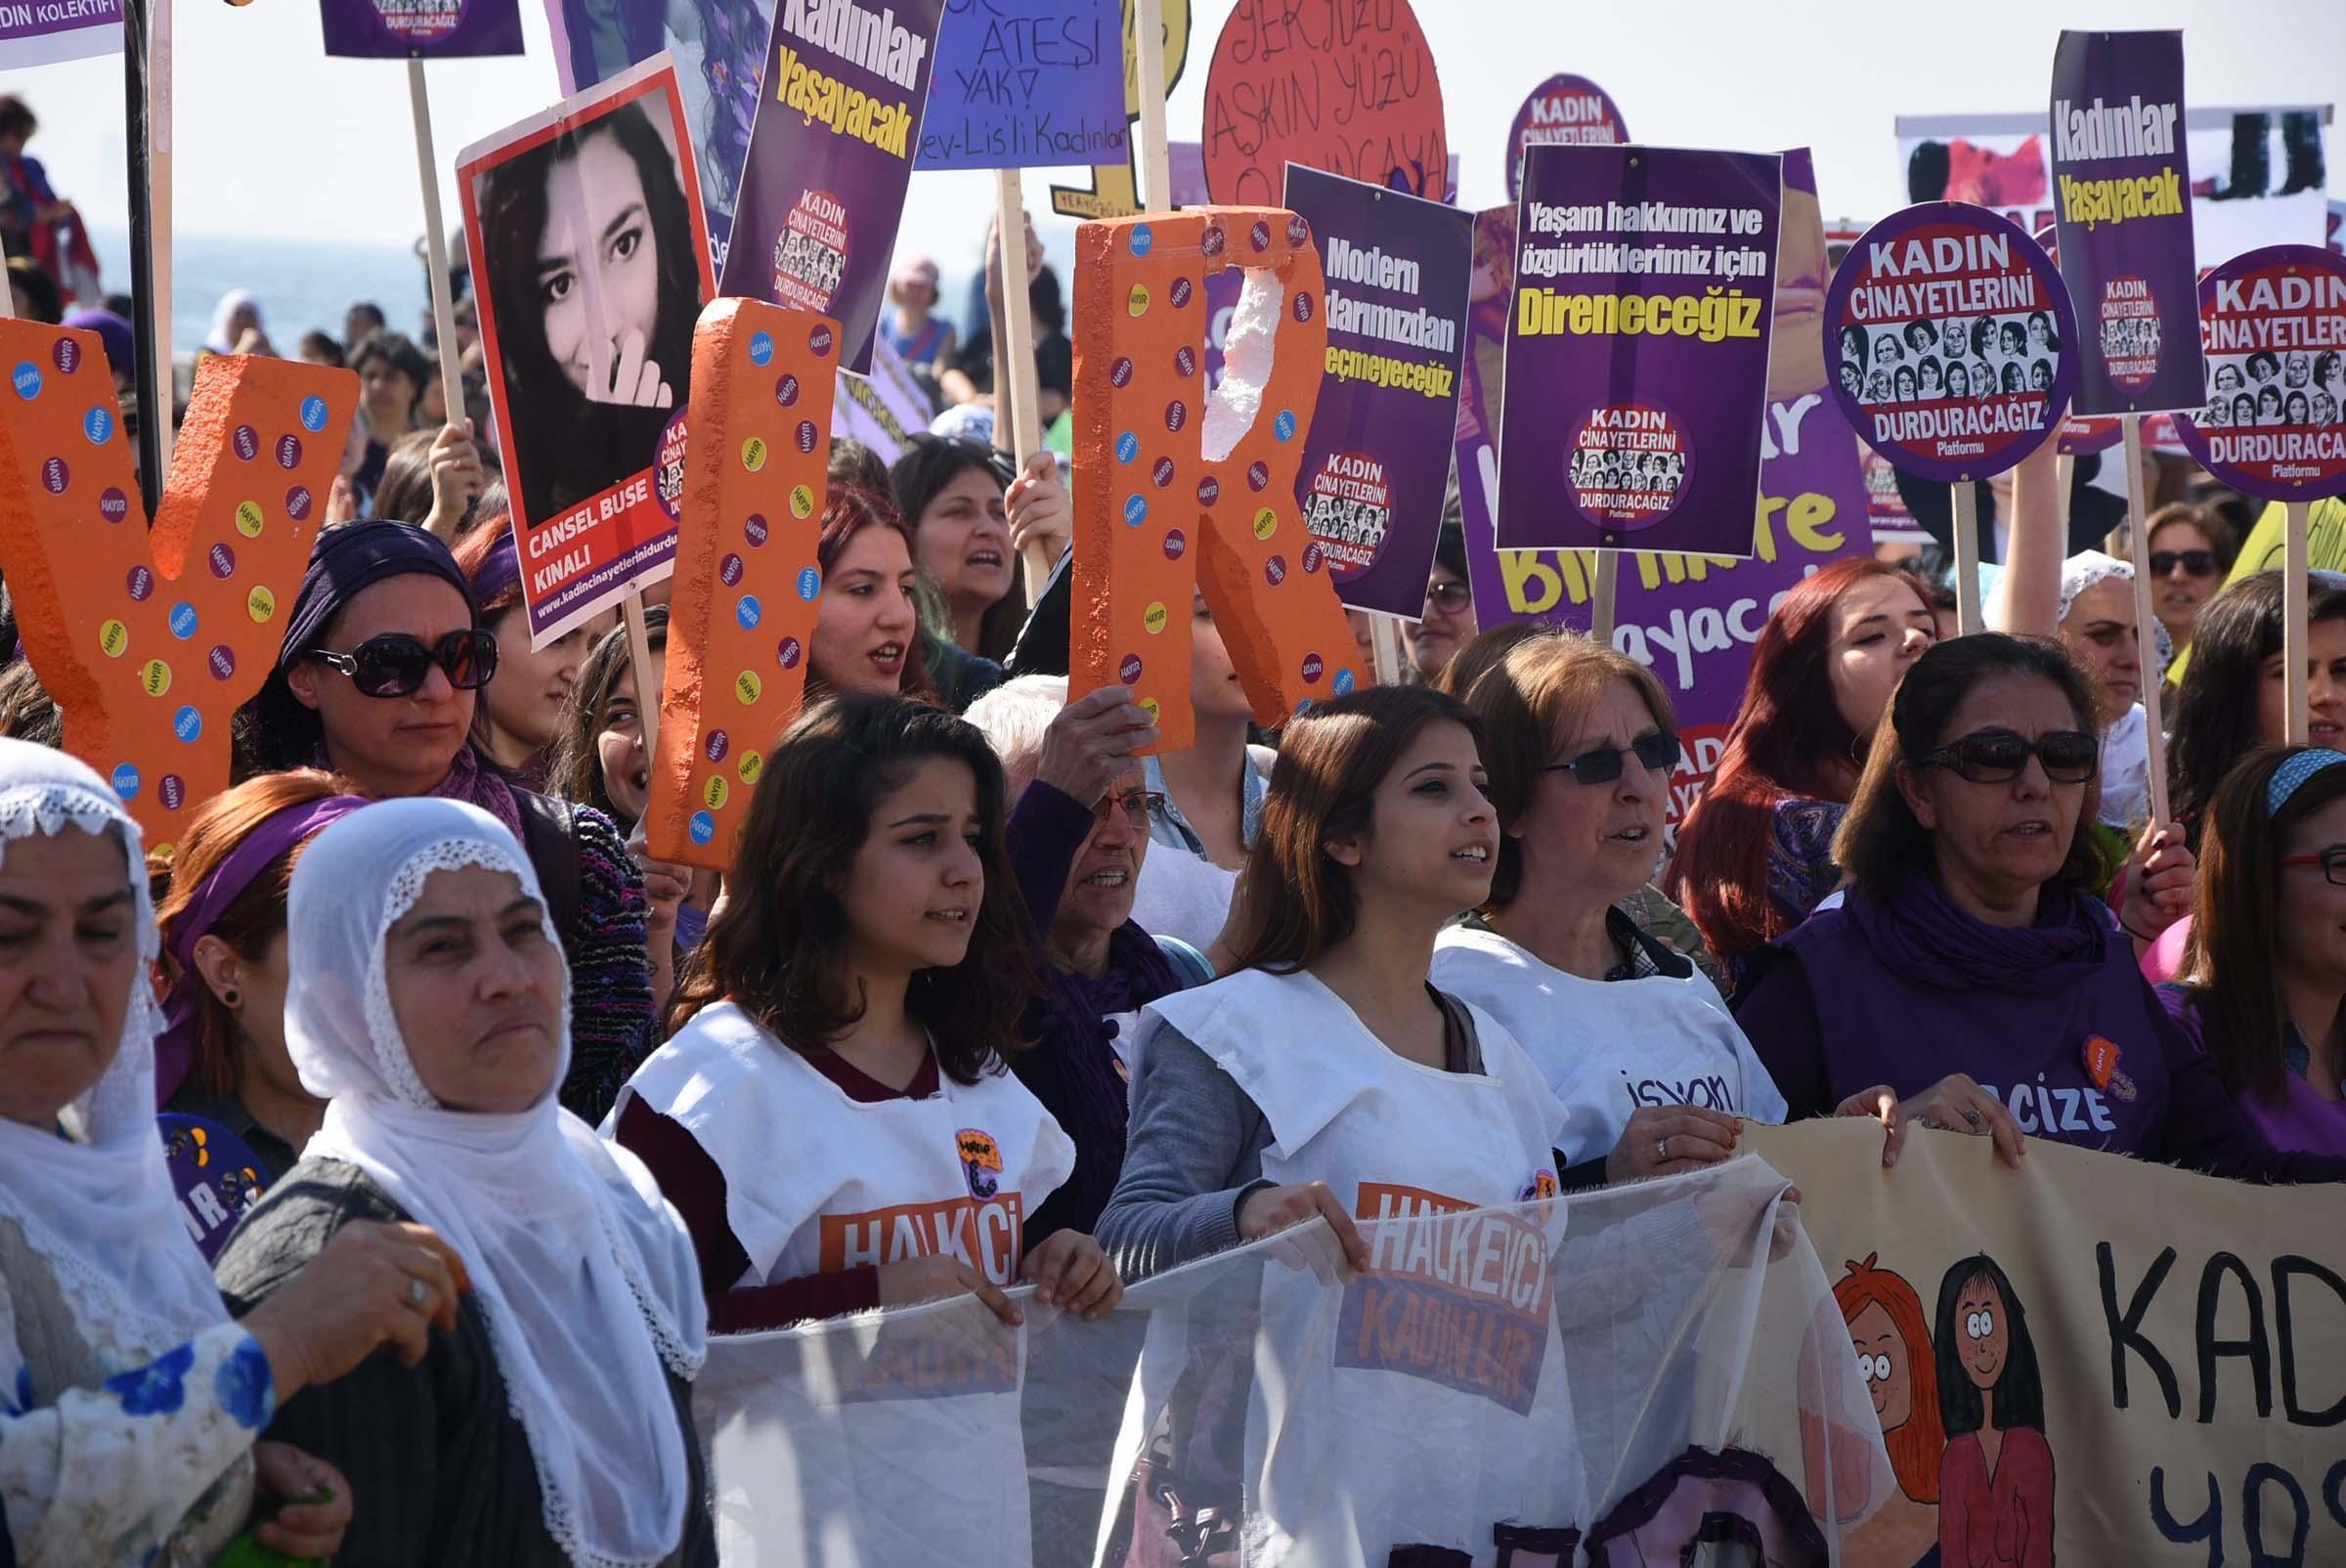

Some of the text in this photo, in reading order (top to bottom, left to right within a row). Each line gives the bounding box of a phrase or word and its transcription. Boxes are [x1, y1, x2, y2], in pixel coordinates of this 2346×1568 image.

[0, 4, 32, 28] DIN
[776, 45, 912, 159] Yaşayacak
[1212, 31, 1420, 163] AŞKIN YÜZÜ
[1531, 95, 1602, 124] KADIN
[1034, 111, 1126, 157] Kadınlar
[2055, 96, 2177, 161] Kadınlar
[801, 189, 846, 226] KADIN
[2059, 166, 2184, 232] Yaşayacak
[788, 206, 847, 251] CİNAYETLERİNİ
[1529, 201, 1762, 239] Yaşam hakkımız ve
[1131, 234, 1151, 246] HAYIR
[1251, 227, 1269, 247] HAYIR
[1326, 237, 1420, 295] Modern
[1521, 242, 1767, 282] özgürlüklerimiz için
[1869, 234, 2010, 279] KADIN
[1171, 281, 1191, 306] HAYIR
[1850, 267, 2035, 321] CİNAYETLERİNİ
[2107, 280, 2147, 298] KADIN
[1297, 292, 1310, 322] HAYIR
[1517, 285, 1762, 342] Direneceğiz
[810, 332, 832, 348] HAYIR
[62, 340, 73, 372] HAYIR
[1112, 360, 1132, 386] HAYIR
[777, 378, 797, 404] HAYIR
[305, 399, 324, 428] HAYIR
[1169, 402, 1182, 431] HAYIR
[1277, 414, 1292, 440] HAYIR
[1591, 409, 1667, 430] KADIN
[1874, 396, 2044, 443] DURDURACAĞIZ
[238, 427, 254, 459] HAYIR
[282, 436, 295, 468] HAYIR
[1579, 427, 1676, 451] CİNAYETLERİNİ
[1937, 441, 1984, 457] Platformu
[746, 439, 762, 468] HAYIR
[49, 458, 63, 492] HAYIR
[1154, 460, 1173, 486] HAYIR
[1249, 466, 1268, 487] HAYIR
[1327, 454, 1382, 482] KADIN
[2273, 463, 2321, 479] Platformu
[794, 487, 811, 514] HAYIR
[1197, 485, 1219, 499] HAYIR
[1314, 471, 1387, 505] CİNAYETLERİNİ
[1580, 491, 1670, 511] DURDURACAĞIZ
[101, 500, 126, 512] HAYIR
[288, 491, 309, 516] HAYIR
[1126, 500, 1147, 524] HAYIR
[239, 505, 261, 532] HAYIR
[529, 478, 648, 559] CANSEL BUSE
[746, 522, 766, 542] HAYIR
[1255, 511, 1275, 536] HAYIR
[211, 546, 232, 576] HAYIR
[534, 544, 591, 594] KINALI
[722, 557, 741, 584] HAYIR
[1267, 560, 1284, 583] HAYIR
[131, 568, 149, 599] HAYIR
[173, 607, 196, 633] HAYIR
[739, 602, 759, 626] HAYIR
[1146, 609, 1166, 626] HAYIR
[104, 623, 123, 652] HAYIR
[211, 648, 232, 677] HAYIR
[779, 641, 800, 666] HAYIR
[149, 662, 163, 694] HAYIR
[1120, 660, 1141, 678] HAYIR
[738, 675, 758, 702] HAYIR
[709, 733, 726, 761] HAYIR
[740, 755, 760, 776] HAYIR
[113, 775, 139, 789] HAYIR
[167, 776, 179, 808] HAYIR
[709, 777, 723, 806] HAYIR
[691, 817, 713, 839] HAYIR
